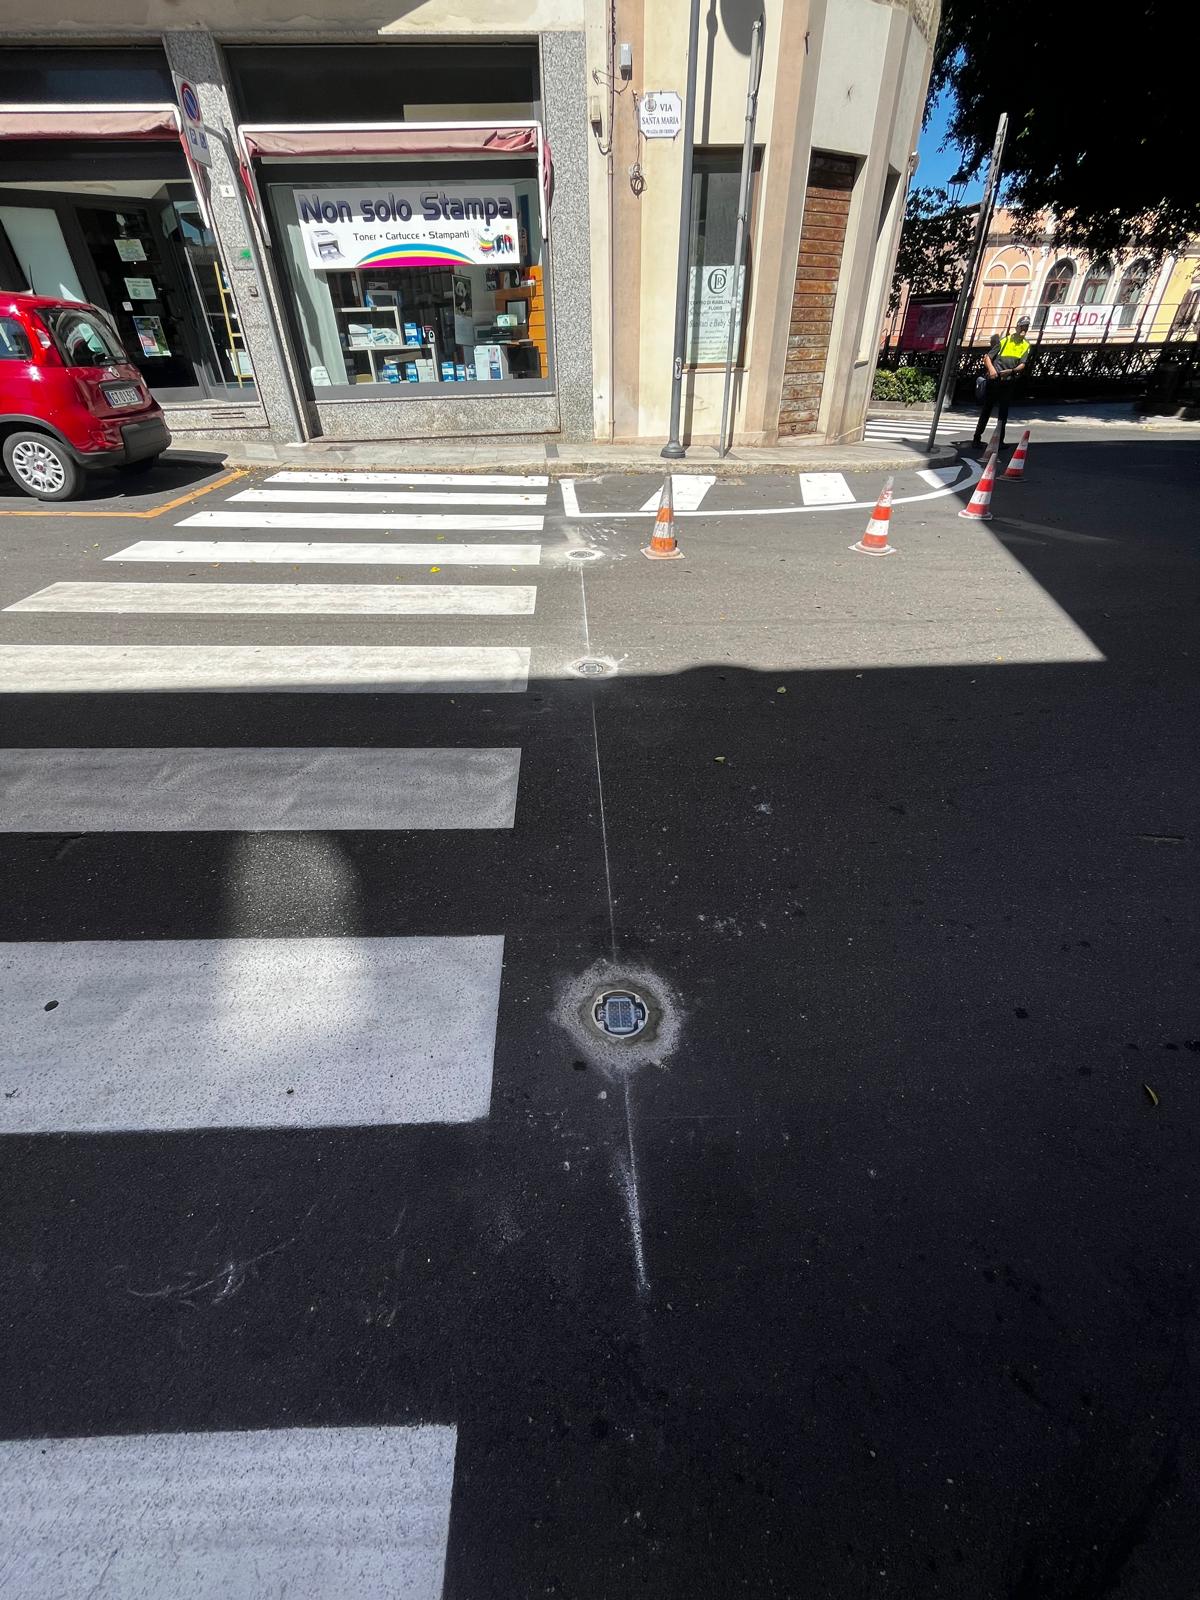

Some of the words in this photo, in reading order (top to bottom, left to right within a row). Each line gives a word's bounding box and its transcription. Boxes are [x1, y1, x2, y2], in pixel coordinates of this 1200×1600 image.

[642, 117, 660, 125] SANTA
[299, 193, 353, 223] Non
[360, 192, 412, 222] solo
[420, 191, 512, 226] Stampa
[353, 233, 376, 241] Toner
[385, 231, 420, 240] Cartucce
[428, 230, 470, 239] Stampanti
